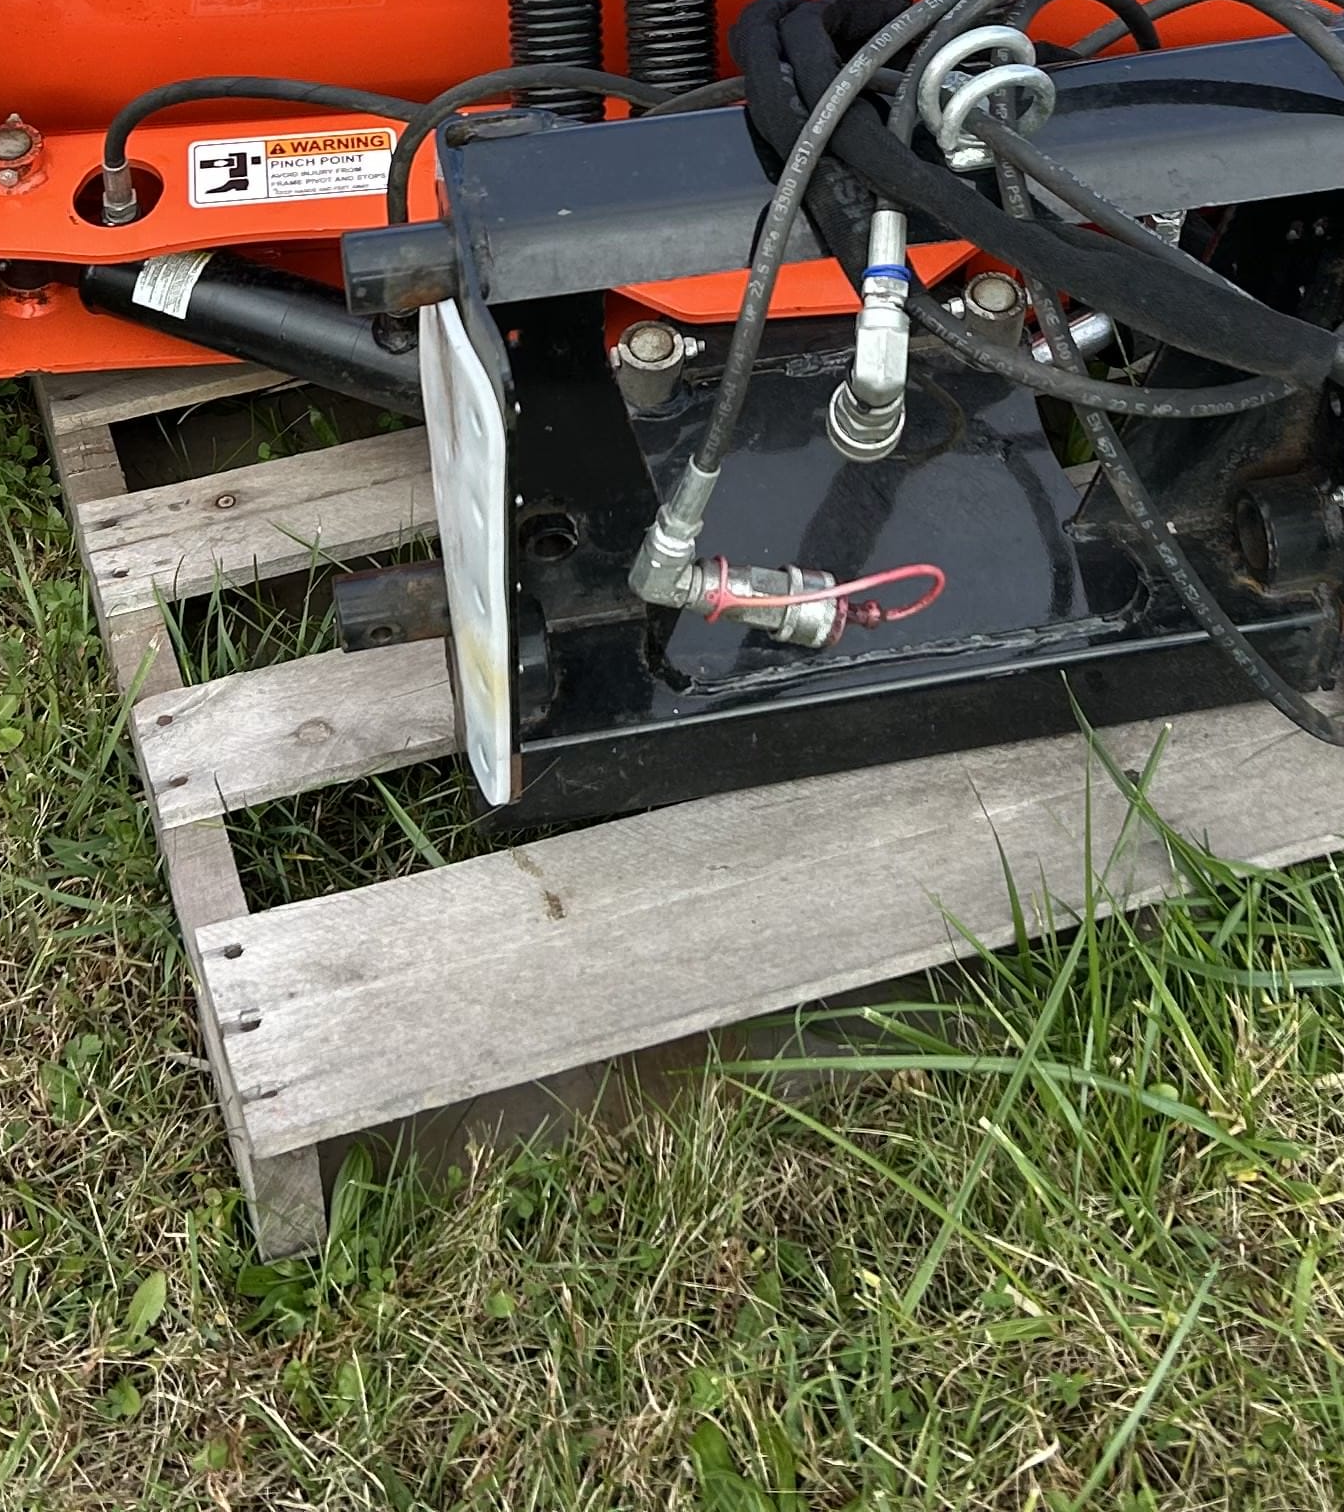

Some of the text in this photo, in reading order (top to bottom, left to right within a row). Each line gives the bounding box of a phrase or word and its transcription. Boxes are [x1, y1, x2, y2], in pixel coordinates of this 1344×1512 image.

[291, 136, 384, 153] WARNING
[271, 154, 364, 168] PINCH POINT
[748, 263, 770, 298] 22.5
[762, 230, 780, 258] MPa
[791, 140, 814, 174] PSI)
[812, 79, 851, 135] exceeds
[849, 52, 873, 78] SAE
[870, 31, 892, 53] 100
[890, 14, 914, 32] R17
[1053, 334, 1072, 360] 100
[1087, 412, 1104, 432] EN
